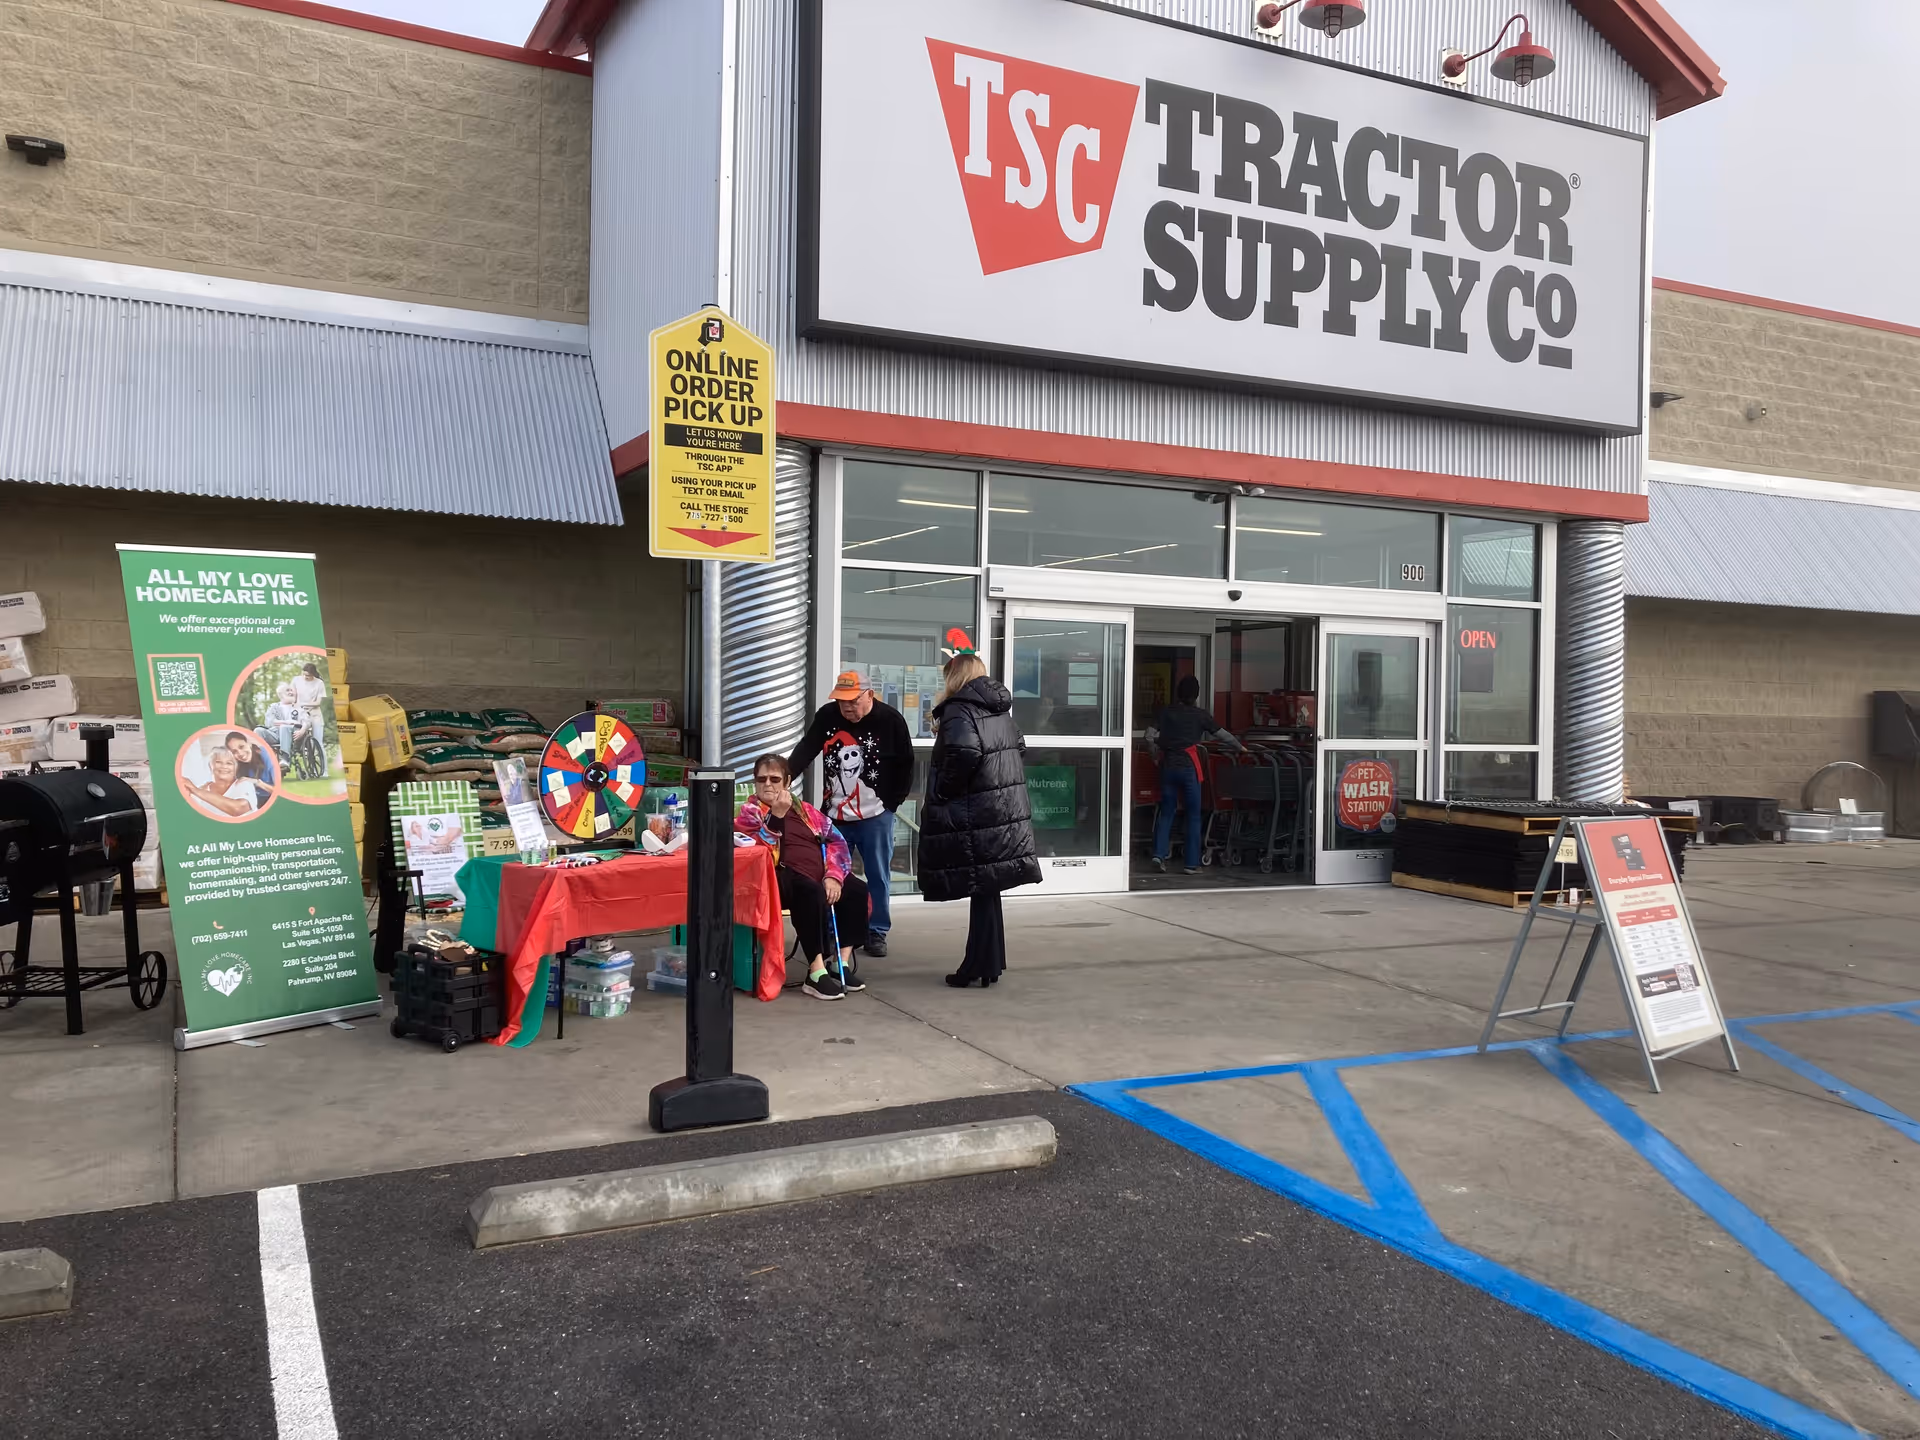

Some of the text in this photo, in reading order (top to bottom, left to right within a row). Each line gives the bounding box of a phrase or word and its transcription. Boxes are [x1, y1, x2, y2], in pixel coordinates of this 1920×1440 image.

[954, 53, 1100, 243] TSC
[1143, 201, 1480, 354] SUPPLY
[666, 349, 759, 380] ONLINE
[670, 374, 754, 403] ORDER
[664, 397, 763, 427] PICK UP
[686, 428, 743, 441] LET US KNOW
[686, 437, 742, 450] YOU'RE HERE:
[685, 452, 744, 465] THROUGH THE
[697, 462, 732, 473] TSC APP
[672, 476, 756, 491] USING YOUR PICK UP
[682, 486, 744, 499] TEXT OR EMAIL
[680, 502, 749, 514] CALL THE STORE
[148, 569, 294, 588] ALL MY LOVE
[1402, 564, 1424, 582] 900
[136, 586, 308, 606] HOMECARE INC
[159, 614, 295, 626] We offer exceptional care
[178, 624, 284, 636] whenever you need.
[1460, 630, 1496, 650] OPEN
[1358, 768, 1375, 780] PET
[1028, 778, 1068, 789] Nutrena
[1343, 781, 1390, 798] WASH
[1348, 801, 1385, 812] STATION
[187, 845, 200, 855] At
[202, 843, 217, 854] All
[219, 842, 235, 852] My
[237, 839, 263, 850] Love
[264, 835, 315, 848] Homecare
[179, 860, 195, 869] we
[197, 856, 222, 868] offer
[222, 852, 280, 865] high-quality
[281, 847, 321, 861] personal
[190, 857, 338, 879] companionship, transportation,
[188, 866, 342, 892] homemaking, and other services
[184, 876, 352, 904] provided by trusted caregivers 24/7.
[272, 922, 290, 930] 6415
[298, 918, 312, 927] Fort
[313, 916, 341, 926] Apache
[191, 930, 248, 945] (702) 659-7411
[292, 924, 343, 938] Suite 185-1050
[298, 938, 322, 948] Vegas,
[322, 935, 332, 943] NV
[334, 932, 355, 942] 89148
[282, 959, 300, 968] 2280
[308, 954, 337, 964] Calvada
[338, 951, 356, 960] Blvd.
[304, 965, 323, 974] Suite
[288, 976, 323, 987] Pahrump,
[324, 973, 335, 981] NV
